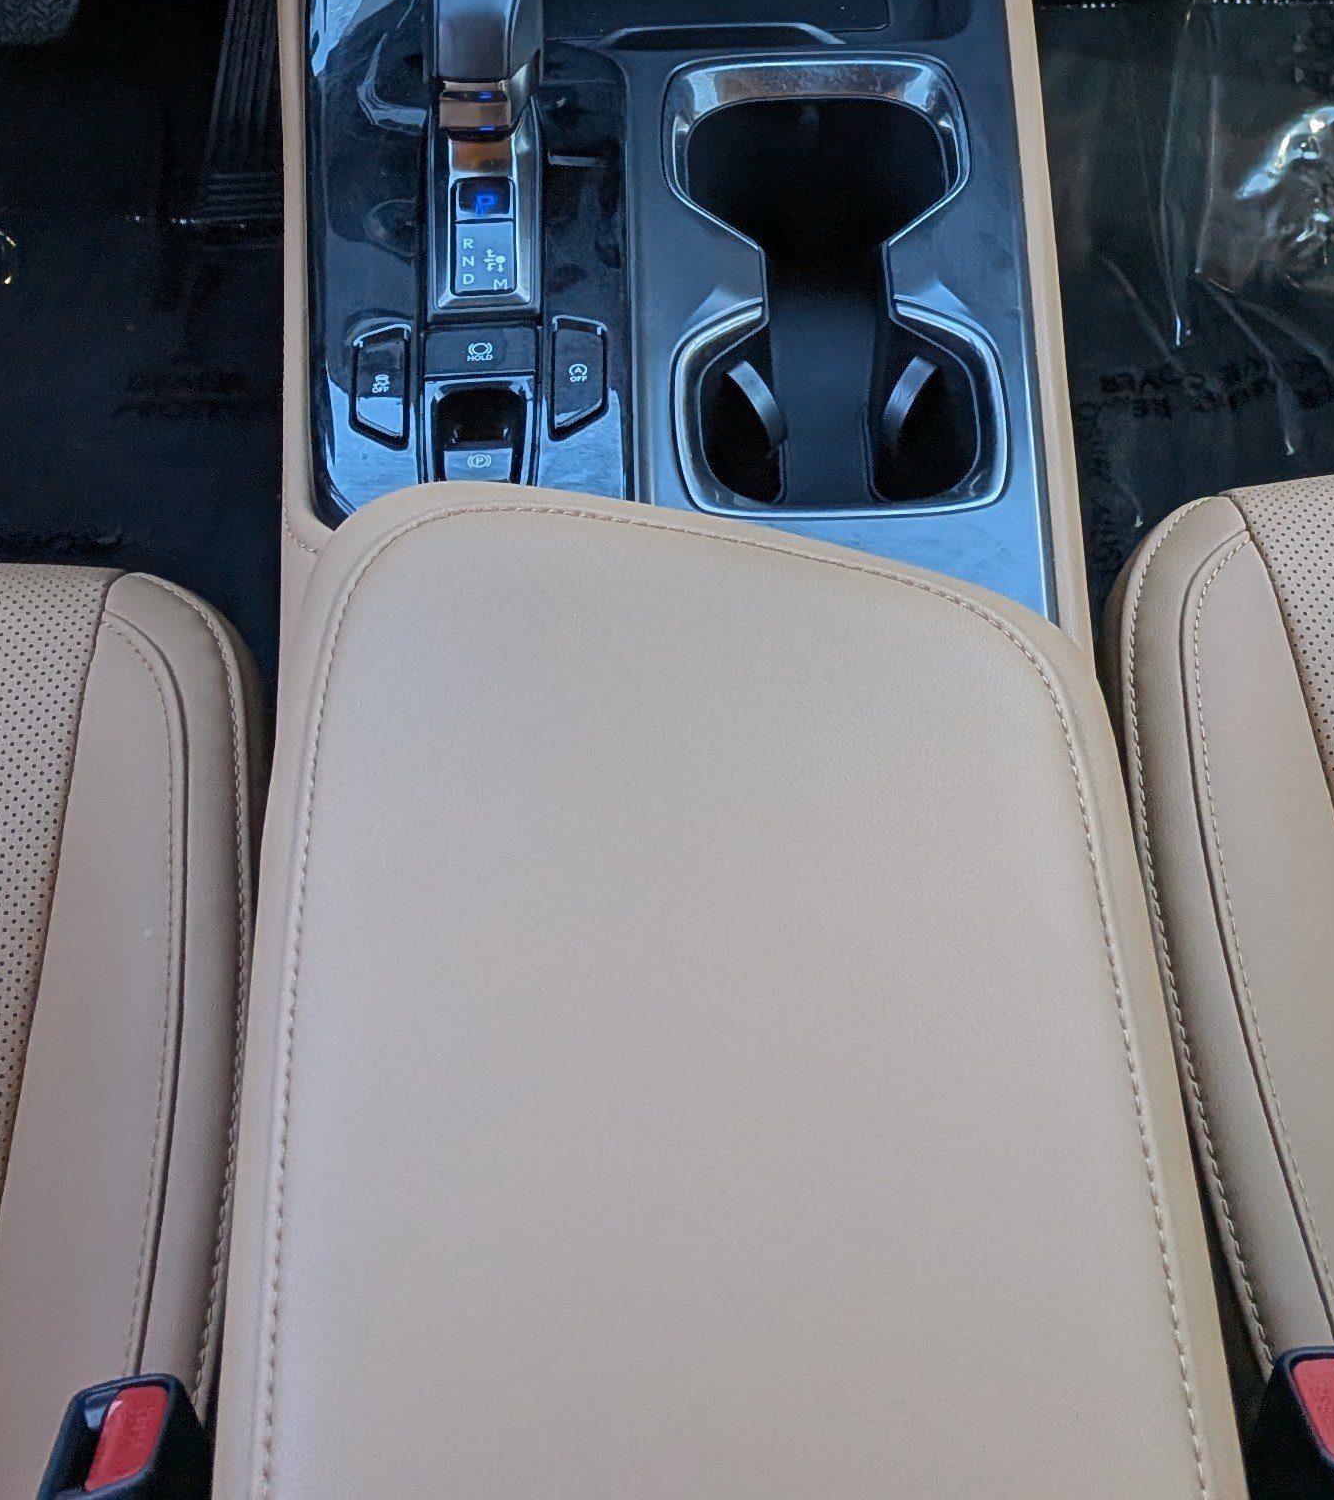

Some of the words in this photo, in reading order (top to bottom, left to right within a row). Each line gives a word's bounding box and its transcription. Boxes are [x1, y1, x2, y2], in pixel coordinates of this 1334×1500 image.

[474, 193, 496, 216] P
[462, 238, 474, 250] R
[462, 255, 475, 267] N
[462, 273, 475, 285] D
[493, 278, 508, 291] M
[467, 354, 493, 362] HOLD
[569, 375, 588, 383] OFF
[371, 385, 389, 394] OFF
